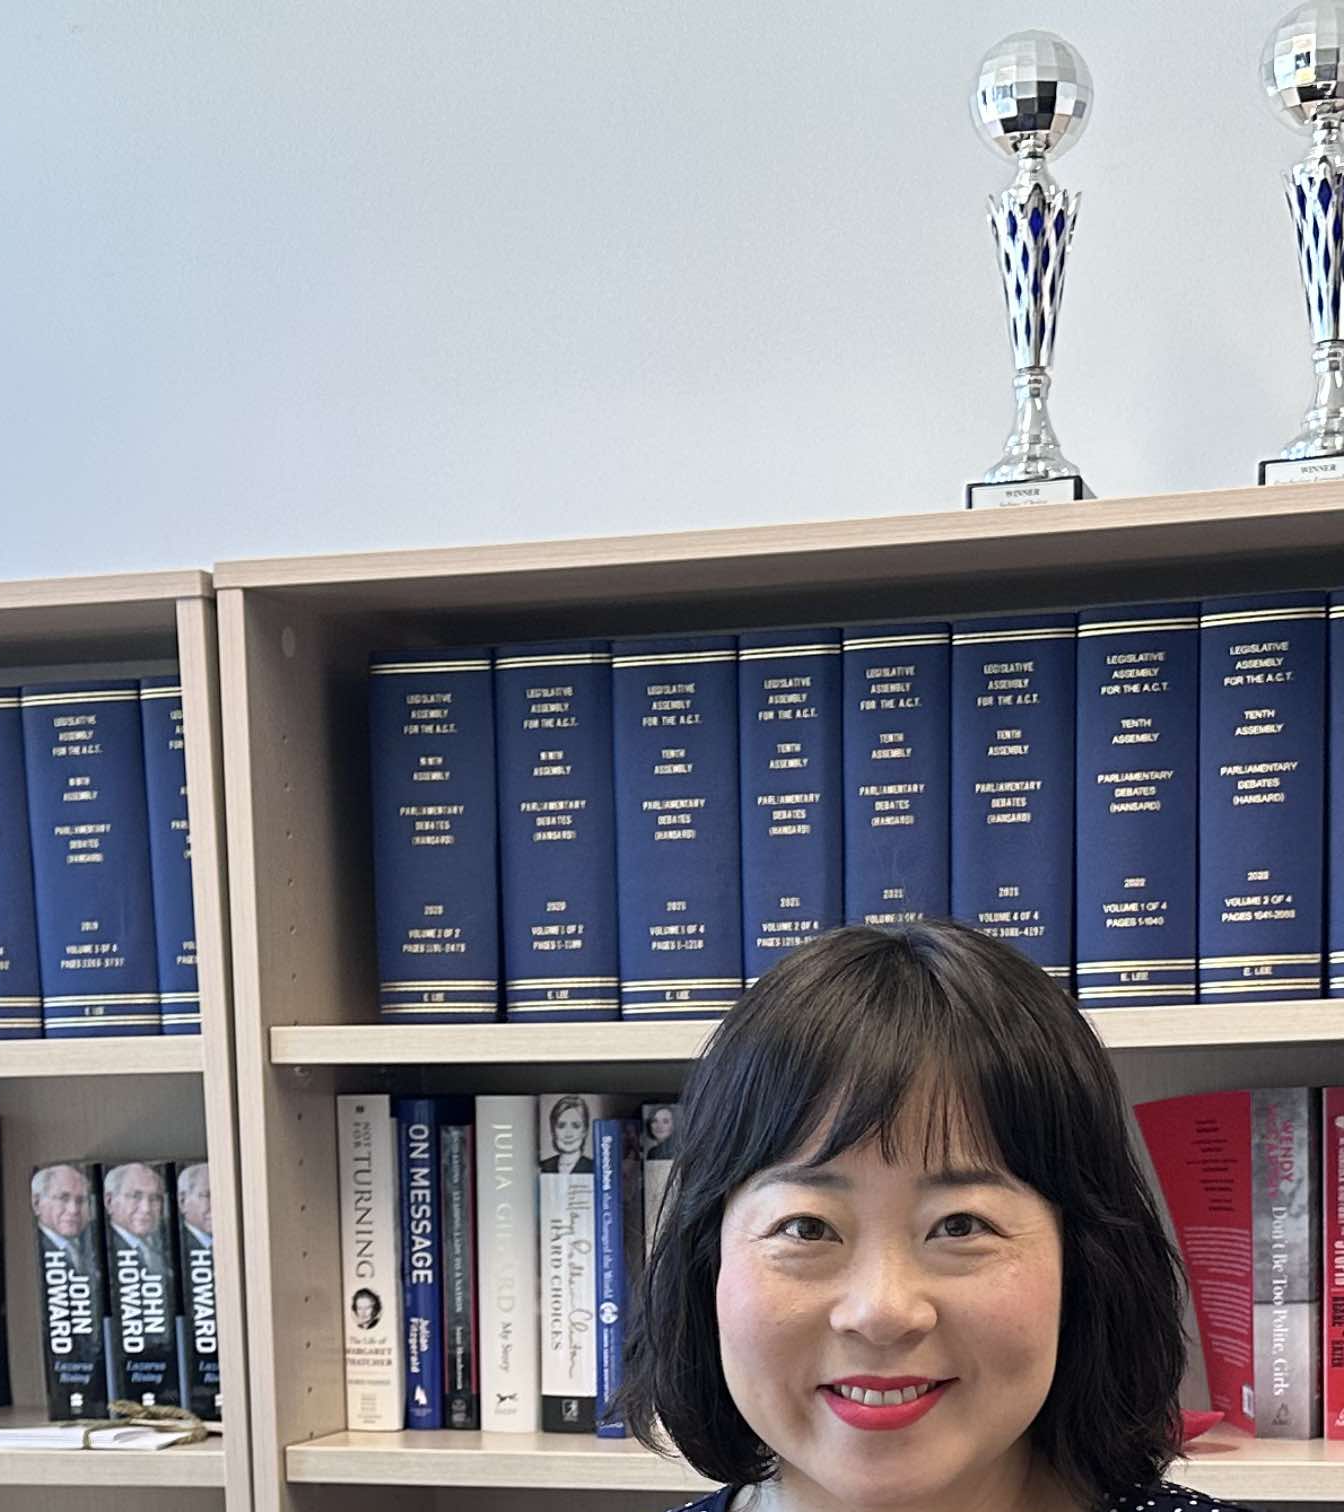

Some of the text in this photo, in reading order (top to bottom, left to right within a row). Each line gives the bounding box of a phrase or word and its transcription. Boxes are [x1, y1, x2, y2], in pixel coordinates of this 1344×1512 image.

[1005, 488, 1040, 497] WINNER
[1301, 464, 1336, 473] WINNER
[492, 1122, 514, 1190] JULIA
[600, 1135, 613, 1190] Speeches
[353, 1151, 375, 1279] TURNING
[409, 1124, 432, 1284] ON MESSAGE
[1272, 1206, 1287, 1247] Don't
[550, 1219, 563, 1351] HARD CHOICES
[1272, 1254, 1287, 1275] Be
[1272, 1279, 1288, 1304] Too
[44, 1250, 72, 1354] HOWARD
[68, 1268, 93, 1335] JOHN
[117, 1249, 144, 1354] HOWARD
[140, 1267, 165, 1334] JOHN
[190, 1249, 217, 1354] HOWARD
[1272, 1357, 1288, 1397] Girls
